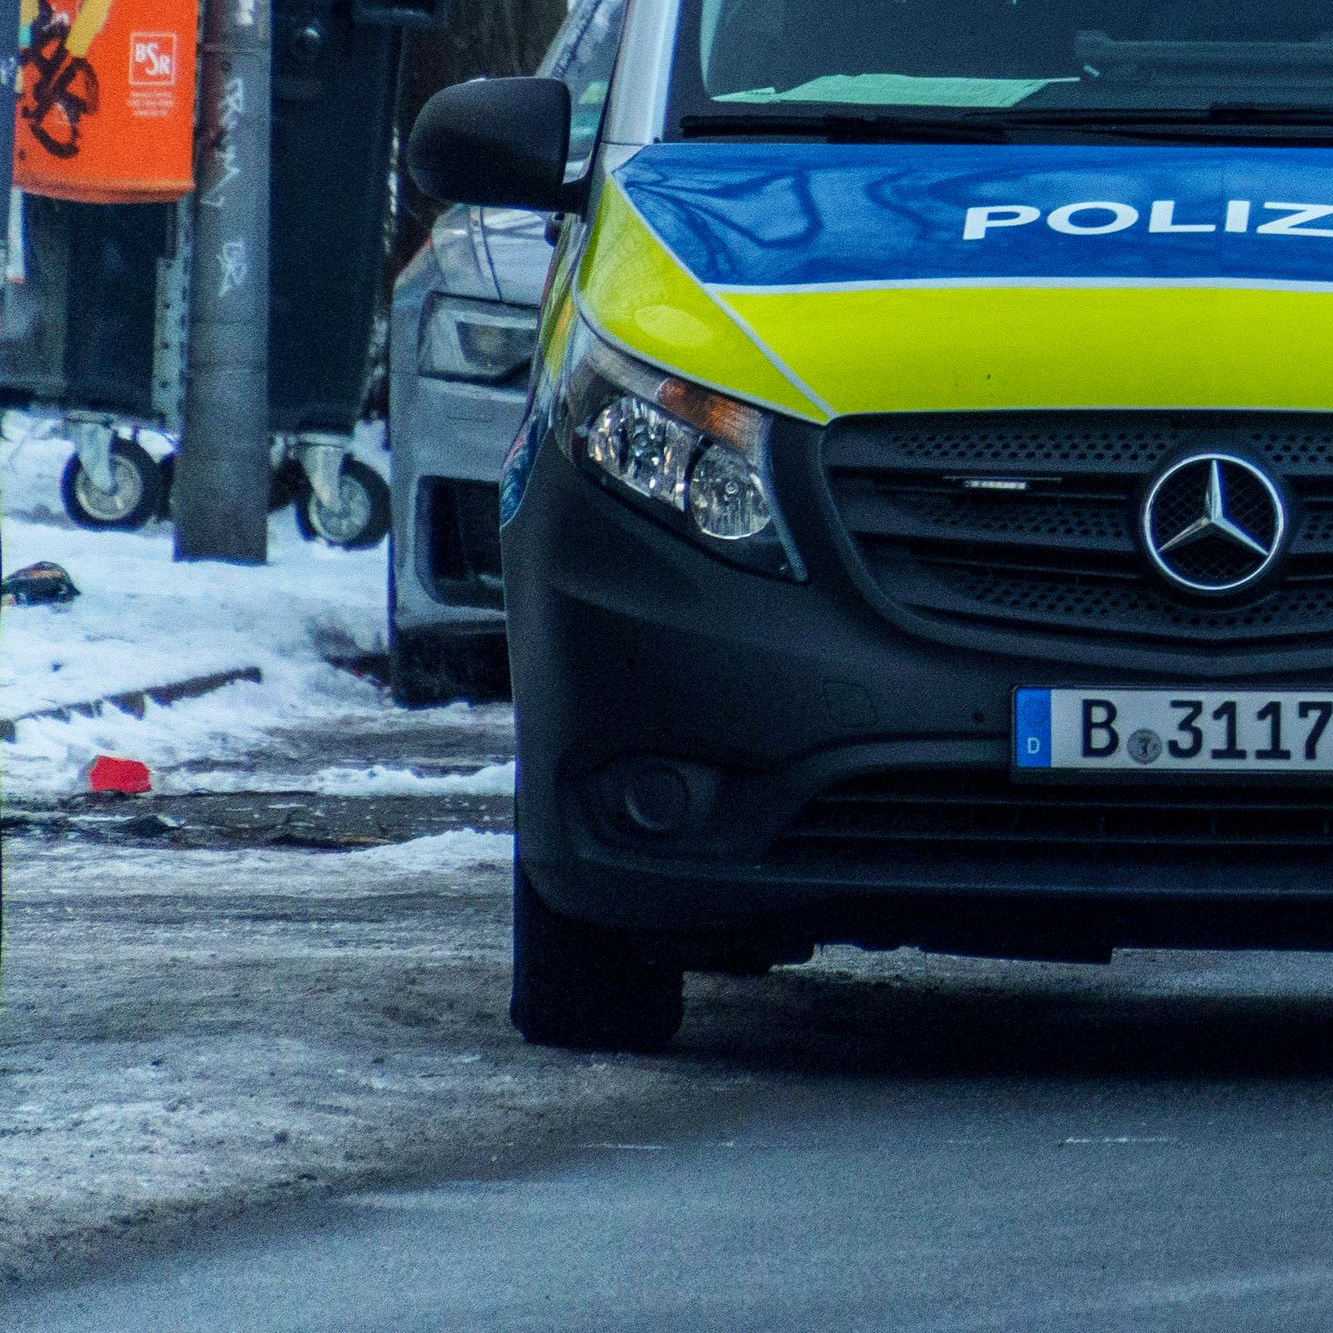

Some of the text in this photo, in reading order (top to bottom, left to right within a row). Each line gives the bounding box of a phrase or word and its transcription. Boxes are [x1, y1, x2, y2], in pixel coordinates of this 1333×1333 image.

[135, 41, 171, 76] BSR
[1027, 737, 1040, 755] D
[1081, 698, 1120, 759] B
